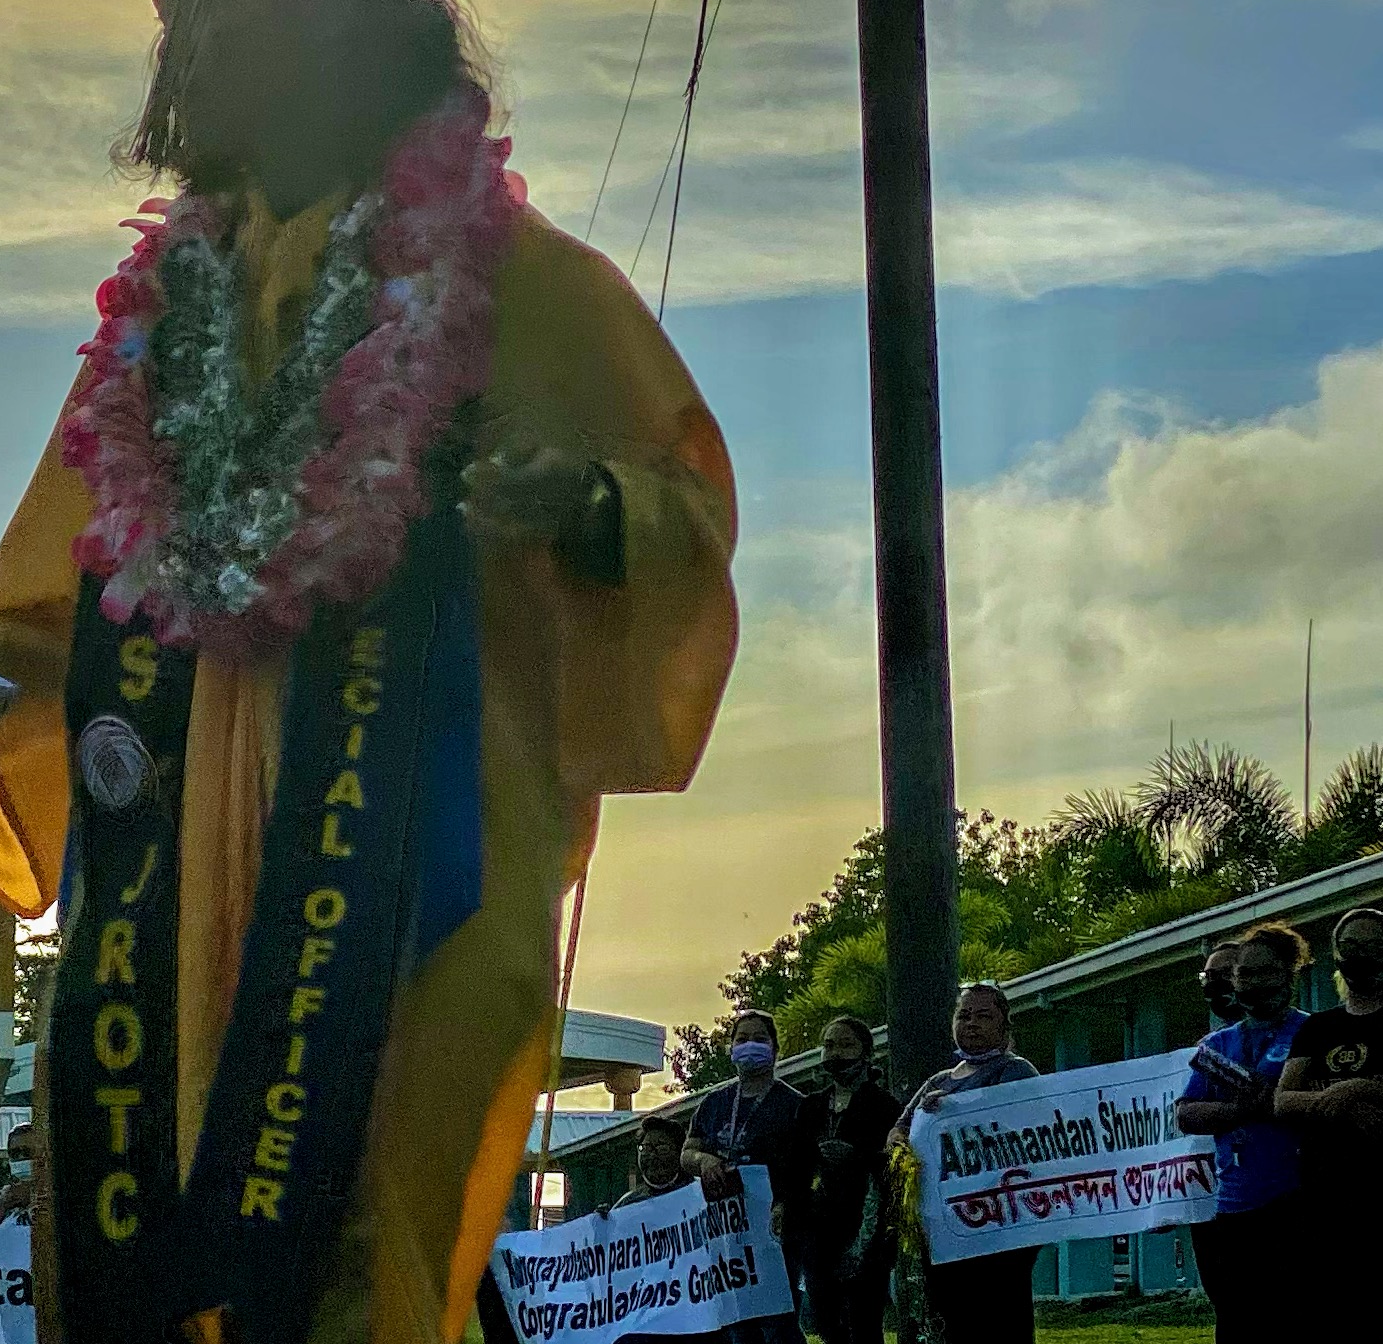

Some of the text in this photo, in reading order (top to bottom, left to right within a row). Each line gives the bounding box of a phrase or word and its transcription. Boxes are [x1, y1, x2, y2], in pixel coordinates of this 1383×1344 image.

[93, 842, 157, 1243] JROTC
[240, 887, 347, 1223] OFFICER
[940, 1109, 1099, 1181] Abhinandan
[607, 1235, 642, 1285] para
